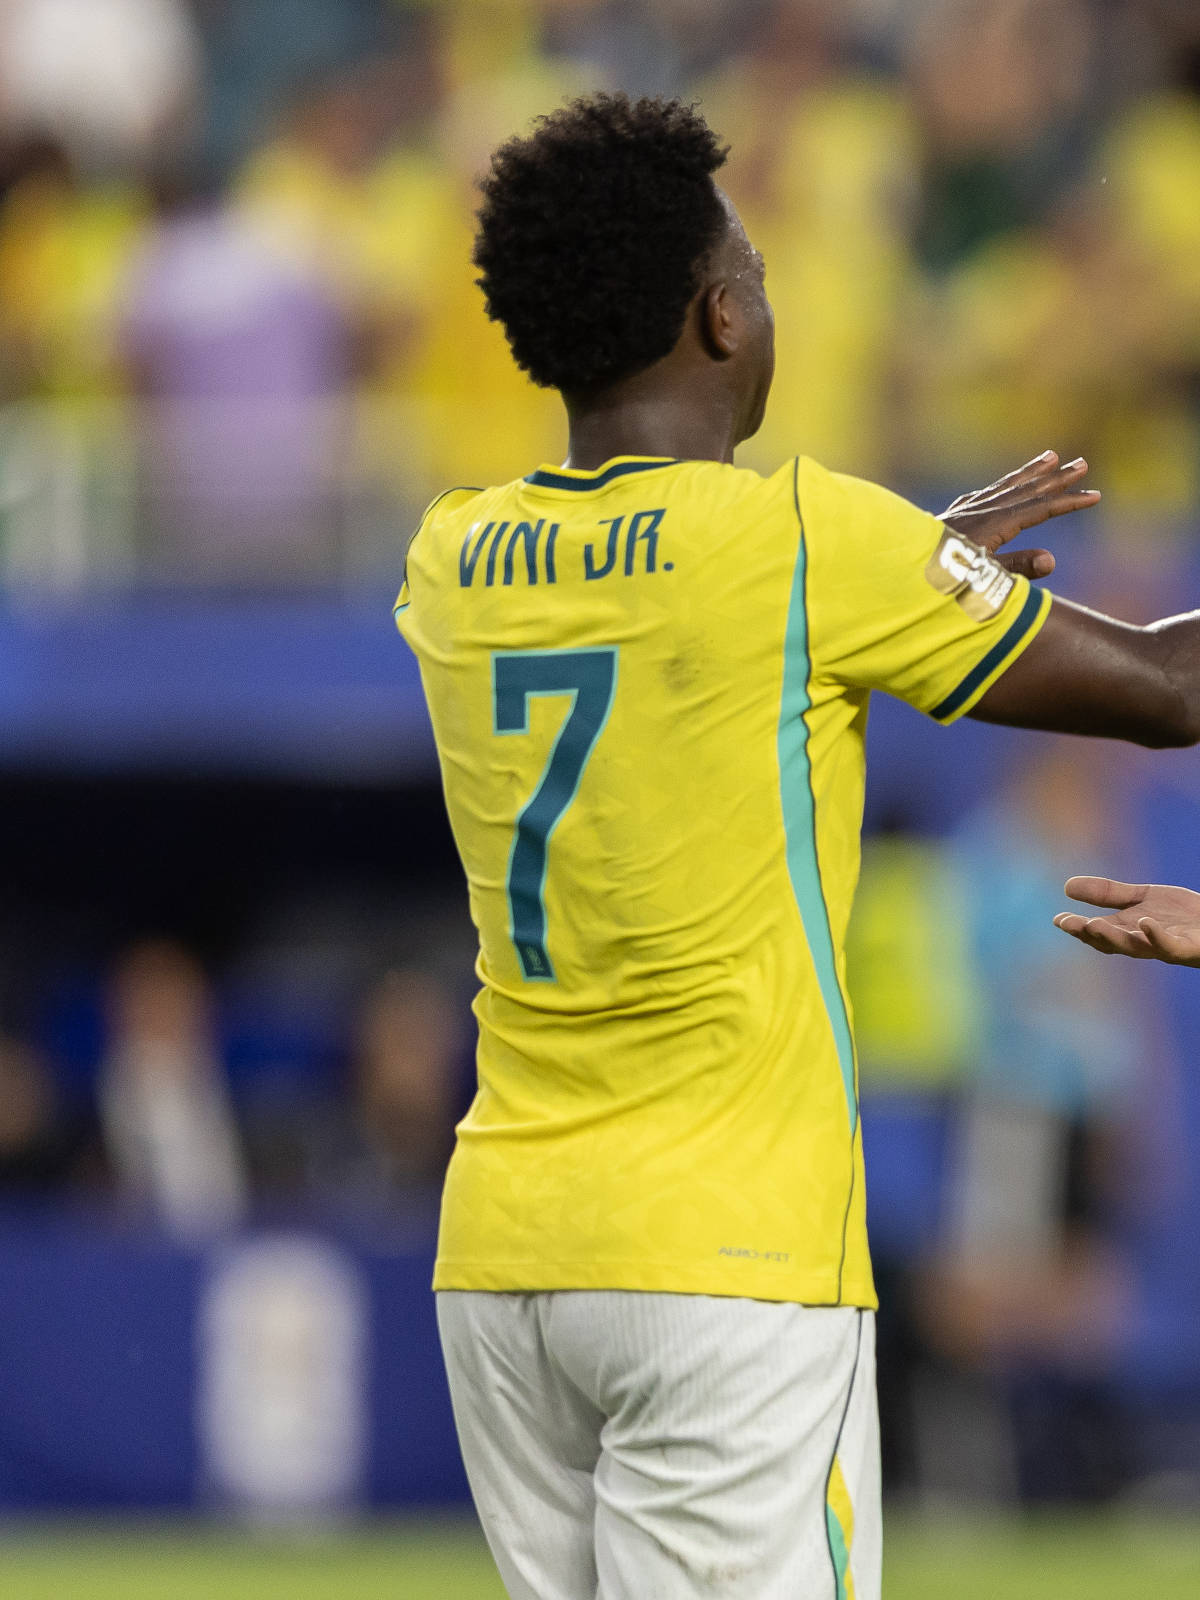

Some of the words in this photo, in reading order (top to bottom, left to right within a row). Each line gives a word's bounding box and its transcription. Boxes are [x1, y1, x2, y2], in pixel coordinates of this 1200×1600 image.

[459, 518, 561, 588] VINI
[583, 508, 675, 581] JR.
[490, 645, 620, 984] 7
